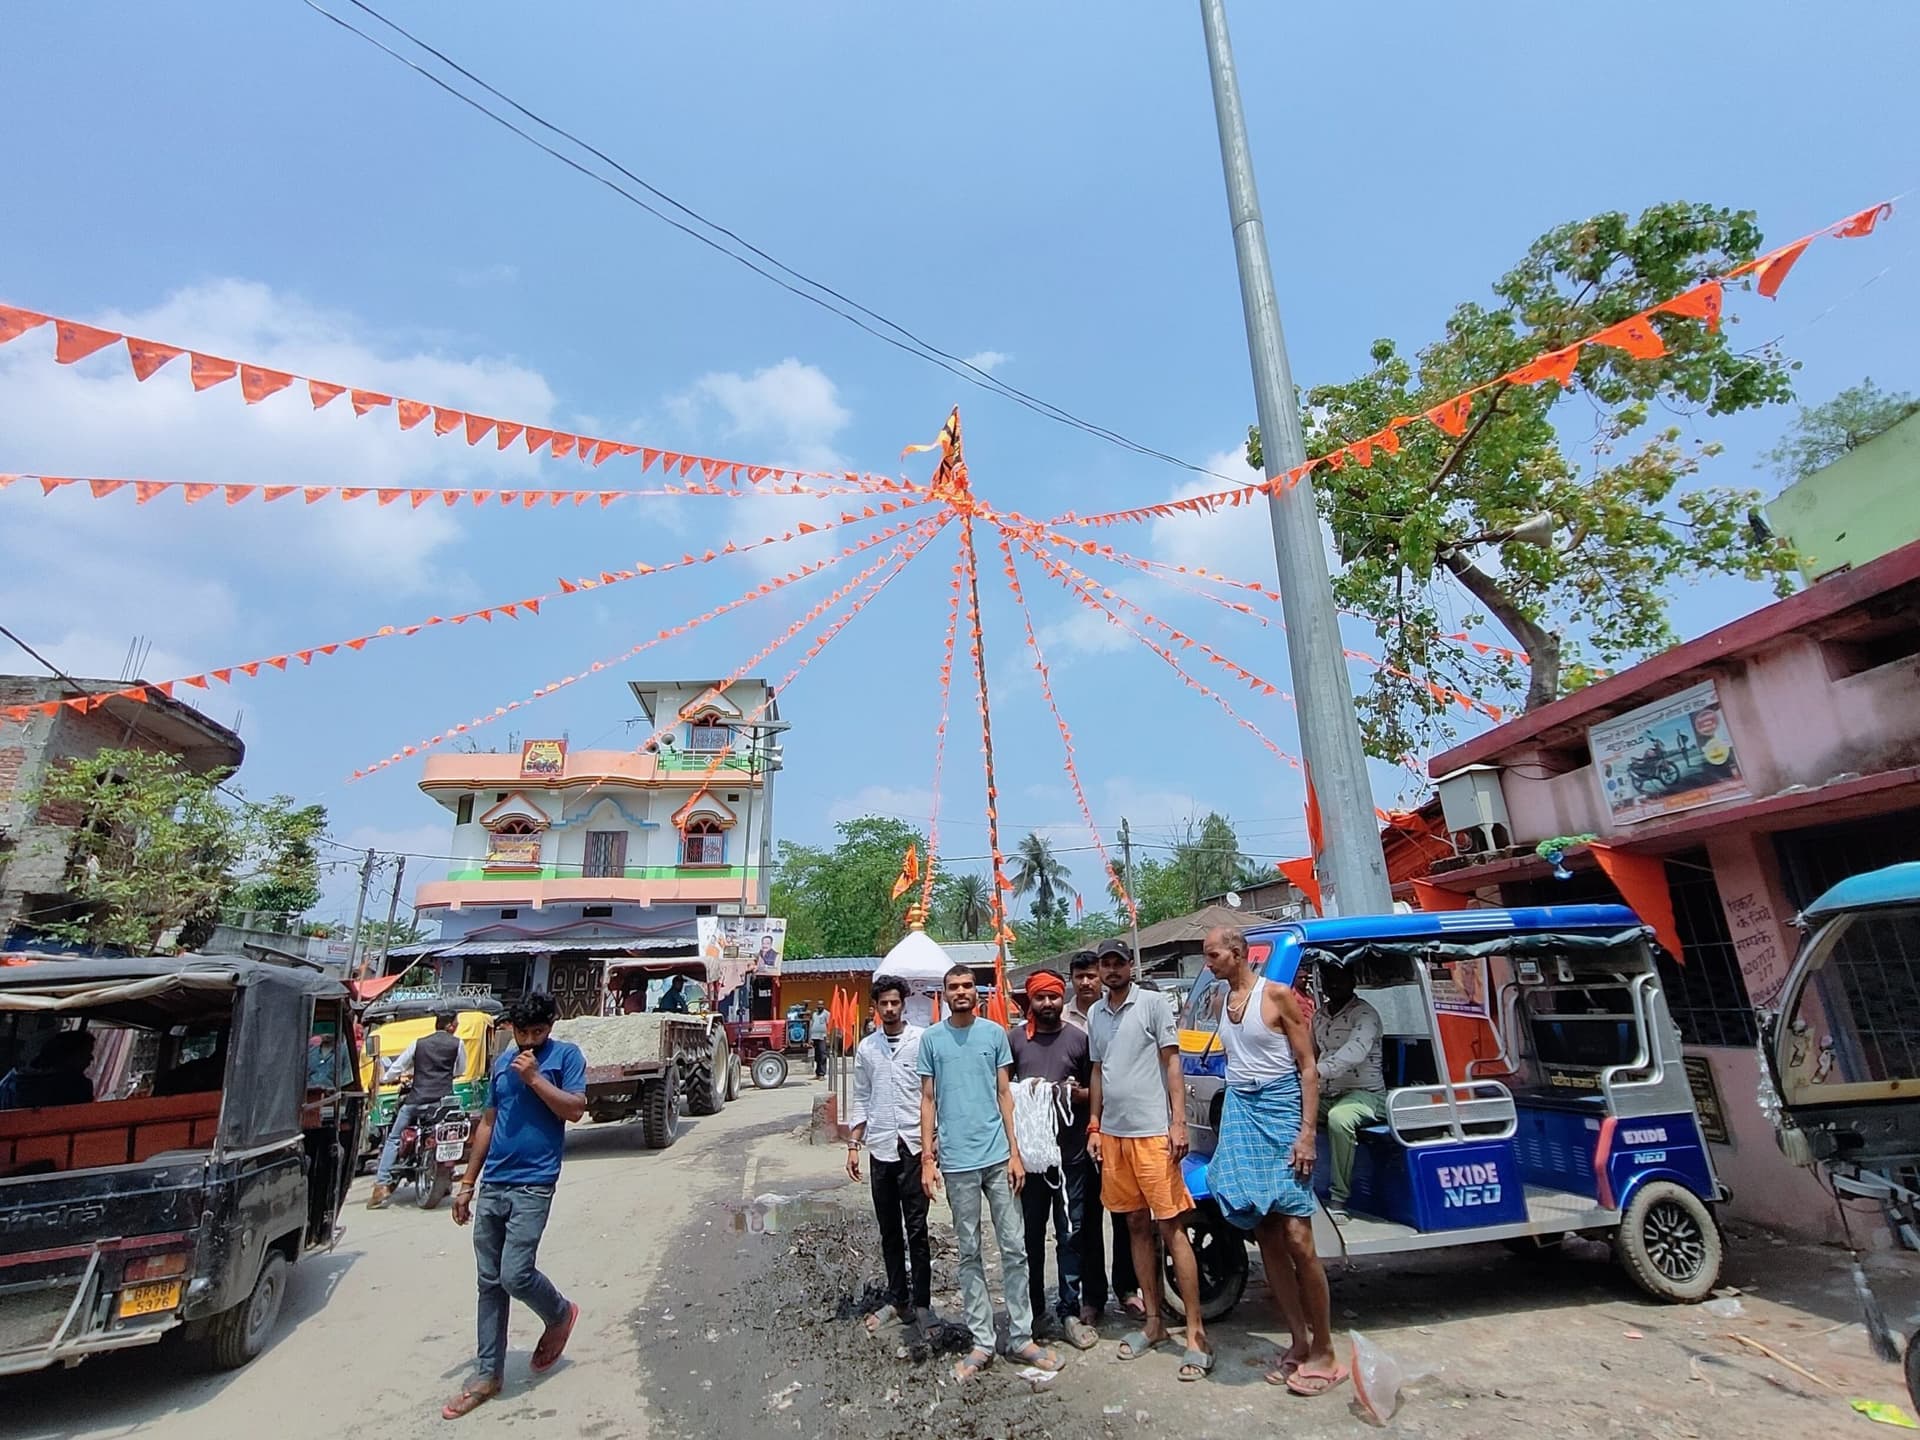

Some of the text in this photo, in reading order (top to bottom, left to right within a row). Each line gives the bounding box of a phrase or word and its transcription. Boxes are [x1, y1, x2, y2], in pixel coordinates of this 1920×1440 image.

[1622, 1128, 1668, 1144] EXIDE
[1634, 1151, 1667, 1164] NEO
[1437, 1162, 1499, 1188] EXIDE
[1444, 1184, 1501, 1208] NEO
[136, 1298, 169, 1312] 5376
